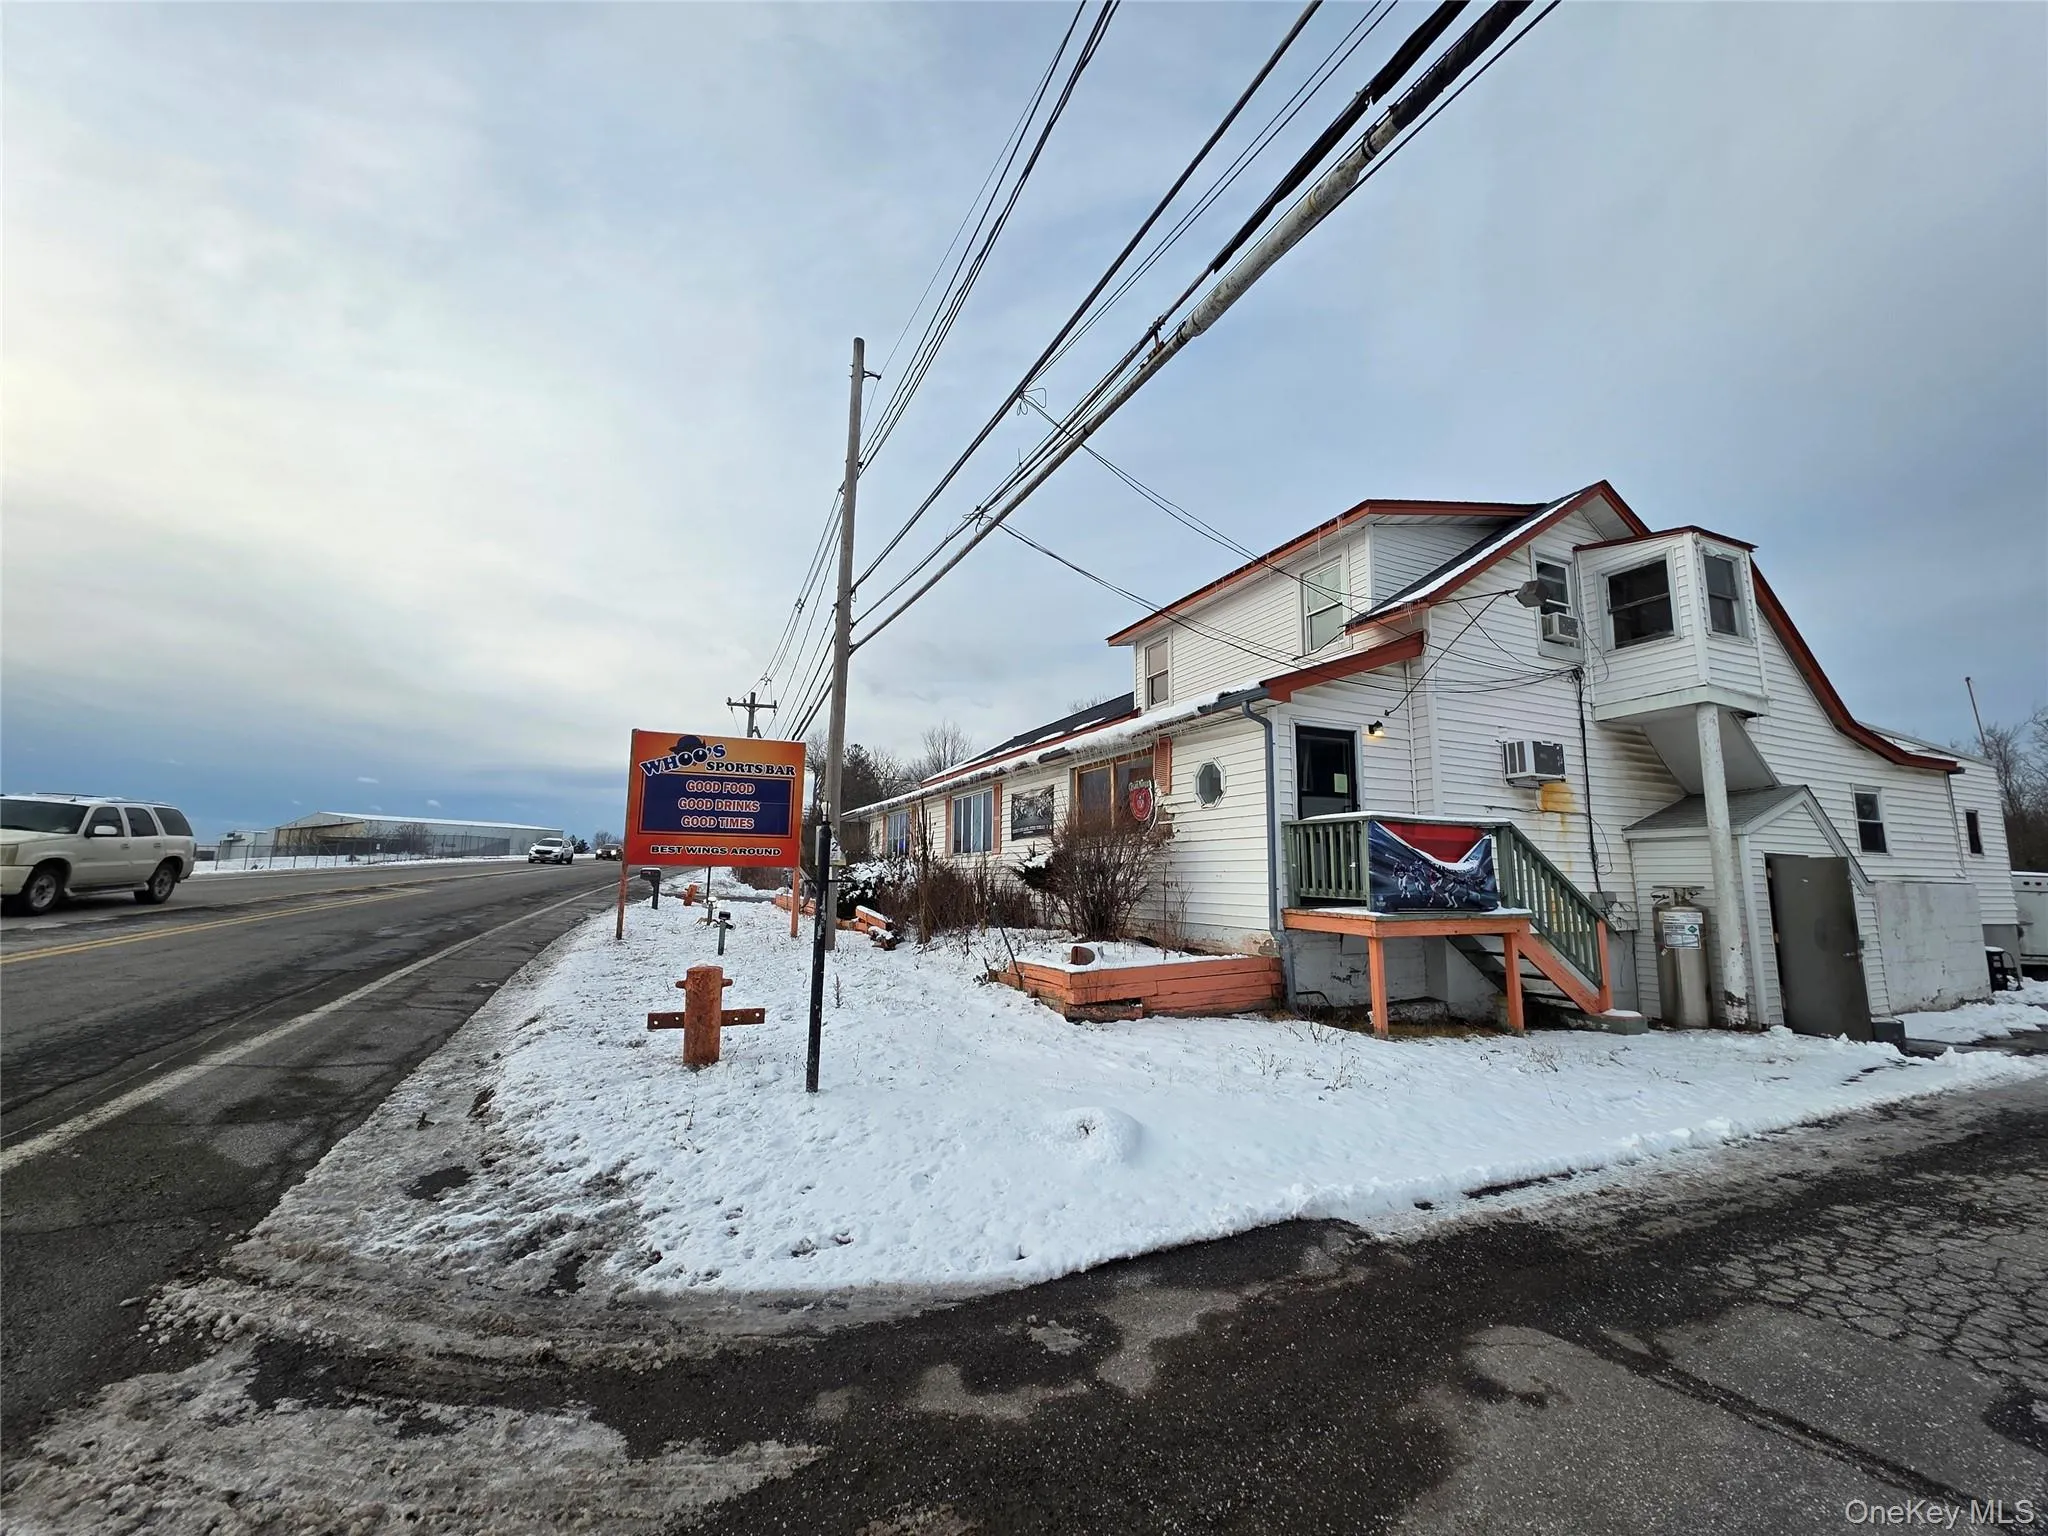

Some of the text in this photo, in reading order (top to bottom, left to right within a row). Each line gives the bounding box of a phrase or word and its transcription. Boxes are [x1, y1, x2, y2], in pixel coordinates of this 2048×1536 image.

[640, 744, 726, 776] WHOO'S
[706, 761, 796, 776] SPORTS BAR
[686, 781, 755, 794] GOOD FOOD
[678, 798, 760, 812] GOOD DRINKS
[681, 816, 754, 829] GOOD TIMES
[651, 845, 781, 856] BEST WINGS AROUND
